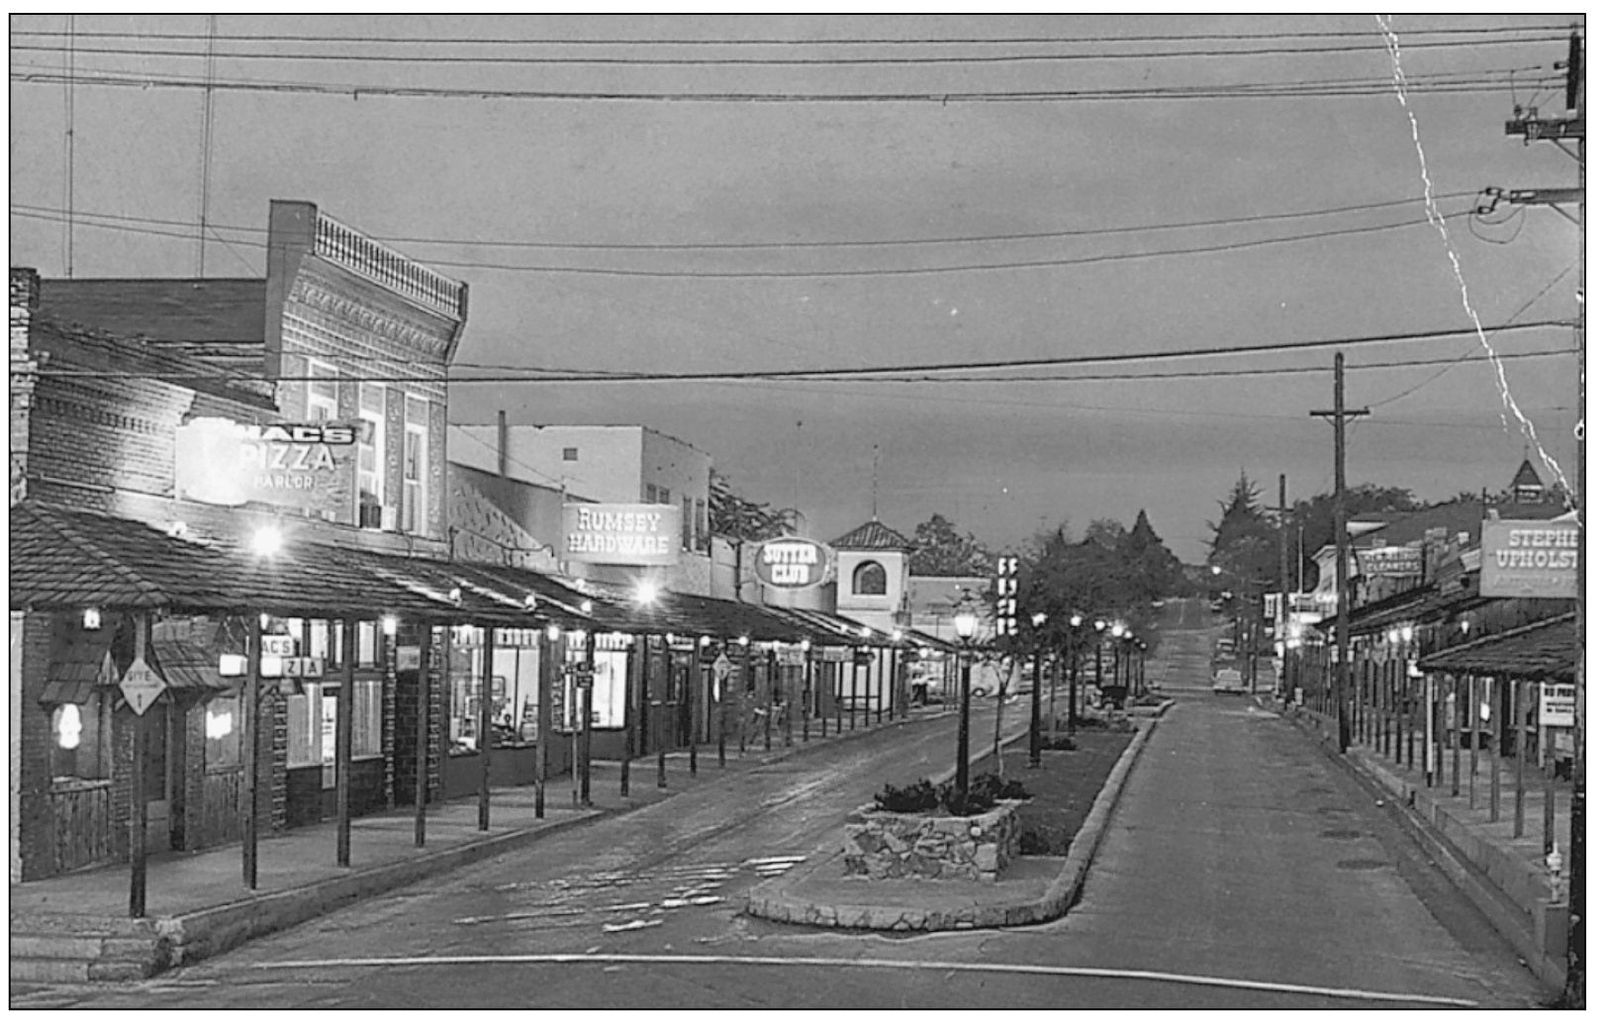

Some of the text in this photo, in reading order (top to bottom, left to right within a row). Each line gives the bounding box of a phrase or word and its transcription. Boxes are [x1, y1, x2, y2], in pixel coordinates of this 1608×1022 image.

[240, 443, 336, 470] PIZZA
[255, 474, 313, 489] PARLOR
[578, 507, 661, 532] RUMSEY
[569, 533, 670, 554] HARDWARE
[1509, 530, 1578, 547] STEPHE
[764, 543, 818, 563] SUTTER
[1496, 550, 1578, 569] UPHOLST
[771, 563, 809, 583] CLUB
